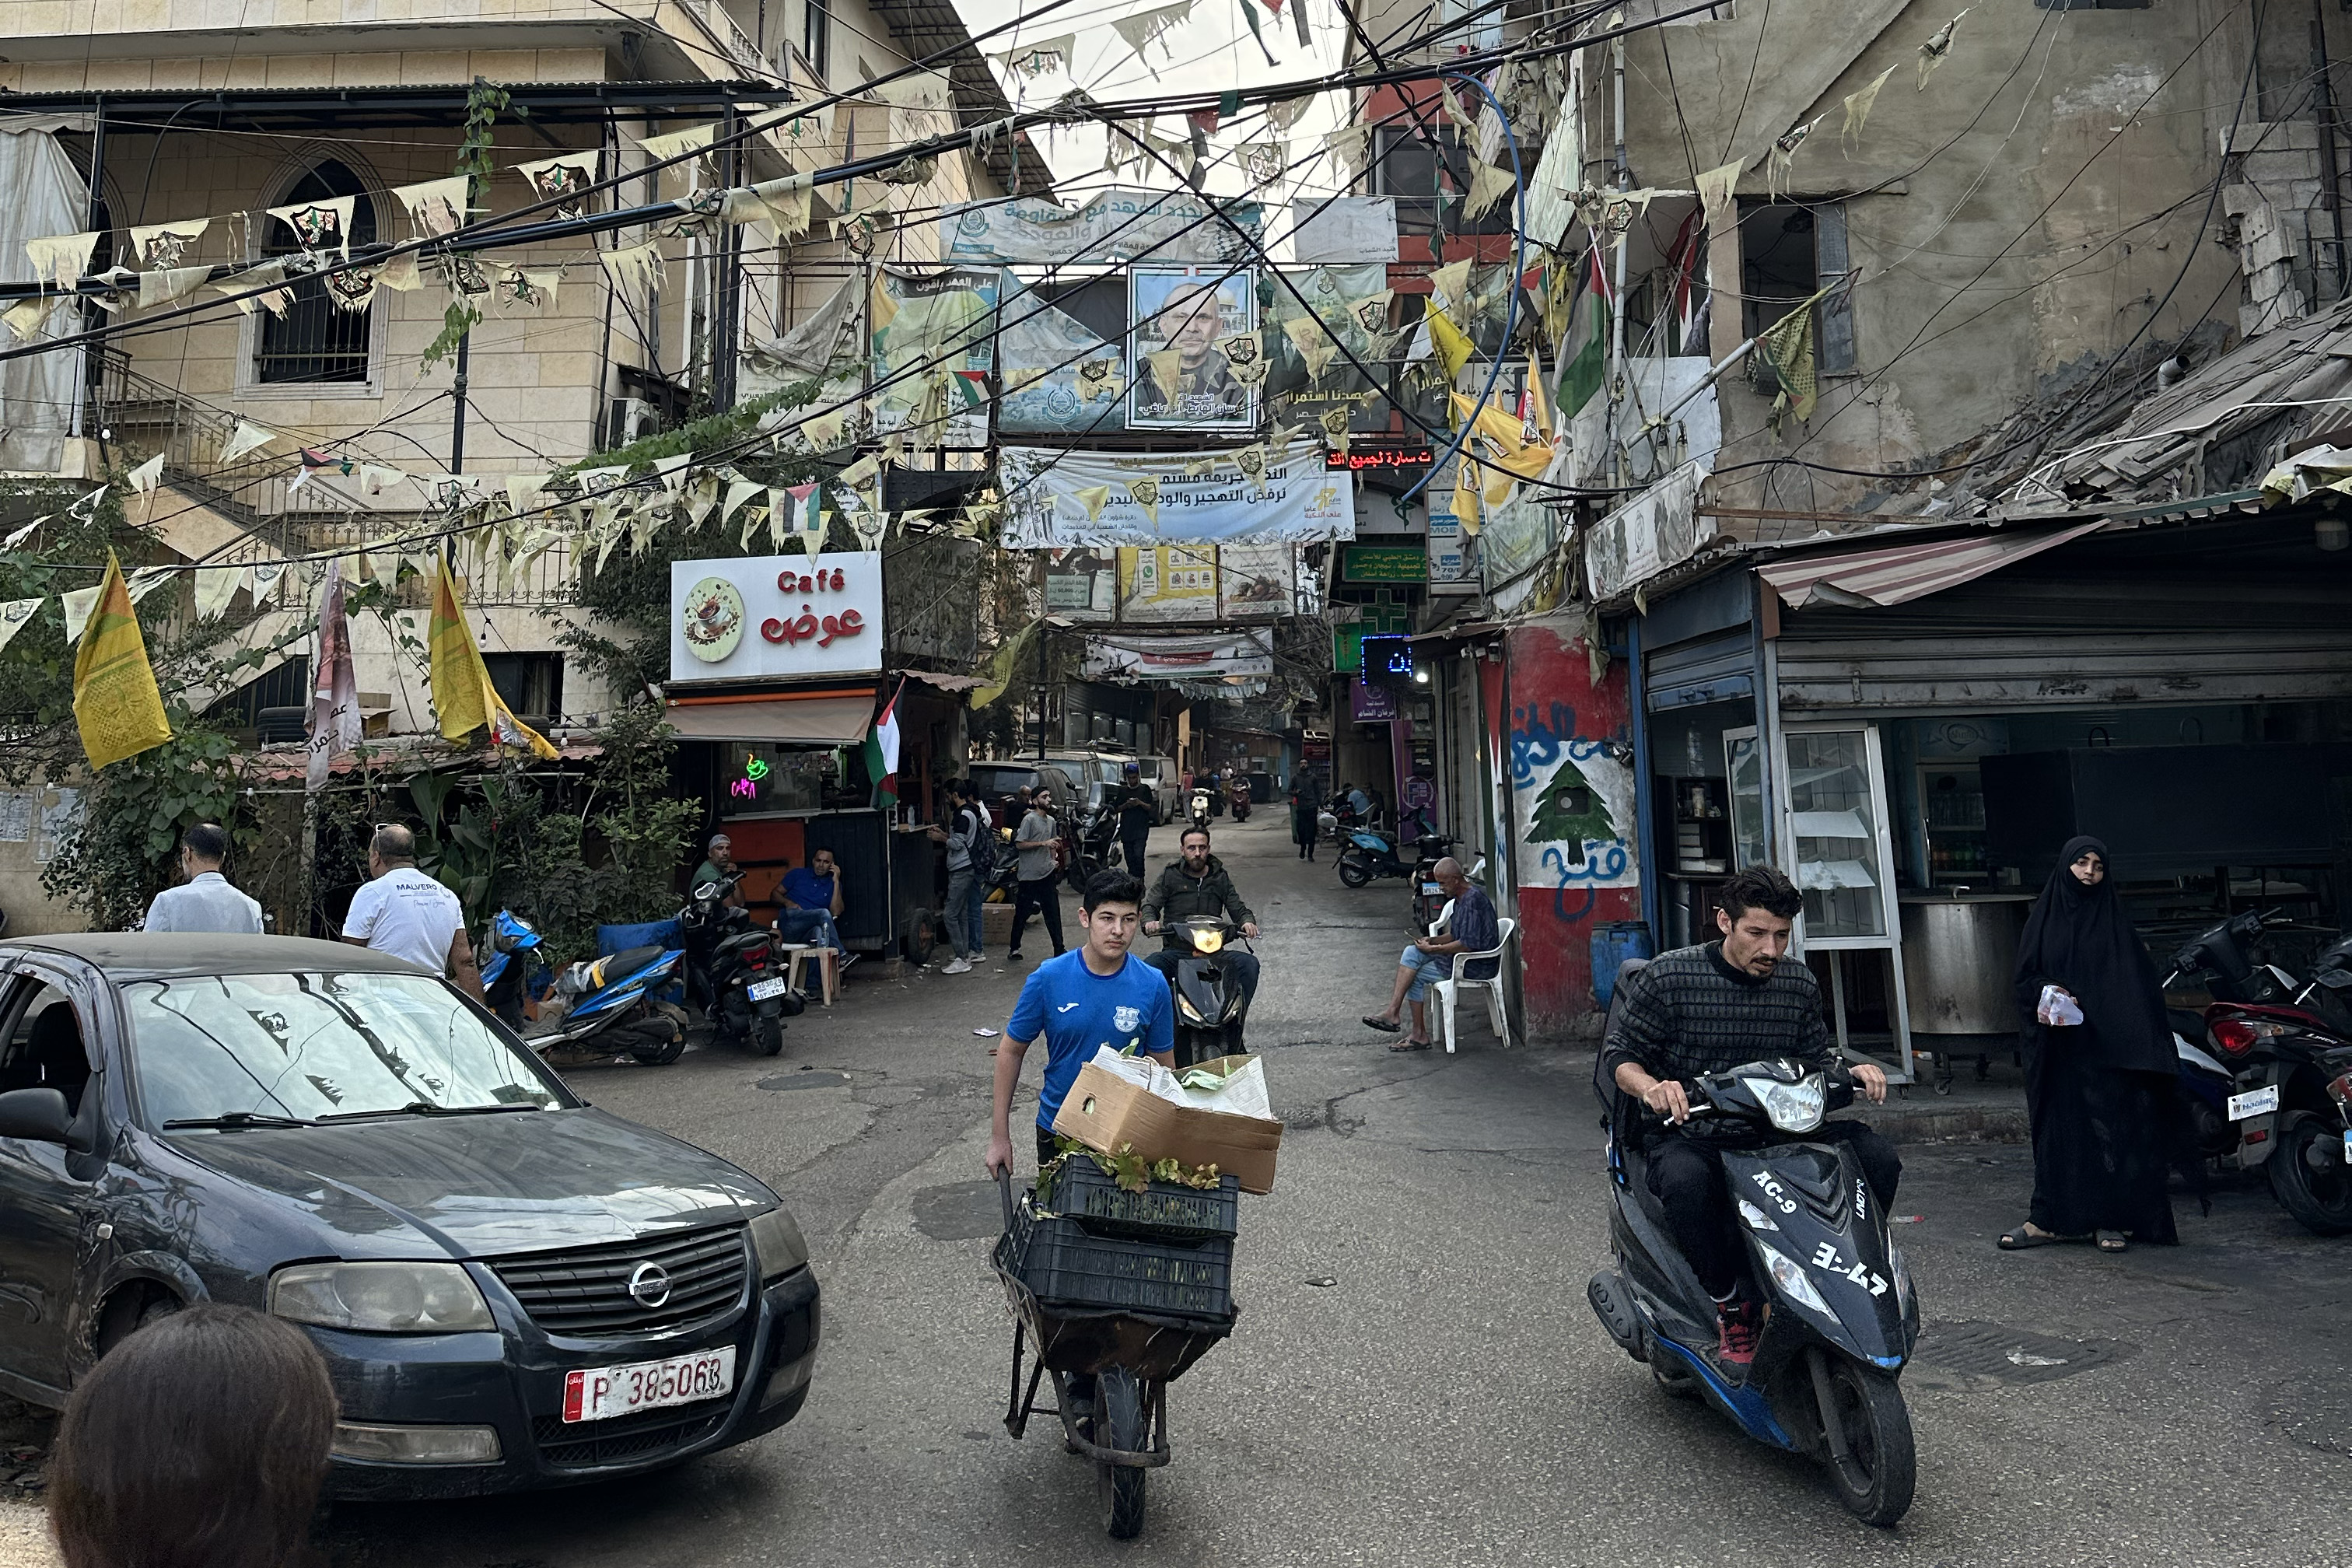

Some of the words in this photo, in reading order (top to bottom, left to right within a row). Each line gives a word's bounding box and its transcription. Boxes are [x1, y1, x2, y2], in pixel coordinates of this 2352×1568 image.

[1085, 204, 1107, 222] مع
[1111, 201, 1162, 216] العهد
[915, 281, 944, 292] باقون
[946, 276, 972, 287] العهد
[973, 278, 993, 292] على
[1286, 389, 1329, 404] استمرار
[1331, 389, 1363, 401] هدنا
[1349, 450, 1384, 470] لجميع
[1385, 450, 1416, 467] سارة
[1195, 489, 1244, 506] التهجير
[778, 568, 845, 593] Café
[761, 604, 865, 649] عوض
[1752, 1170, 1797, 1214] AC-9
[592, 1377, 611, 1414] P
